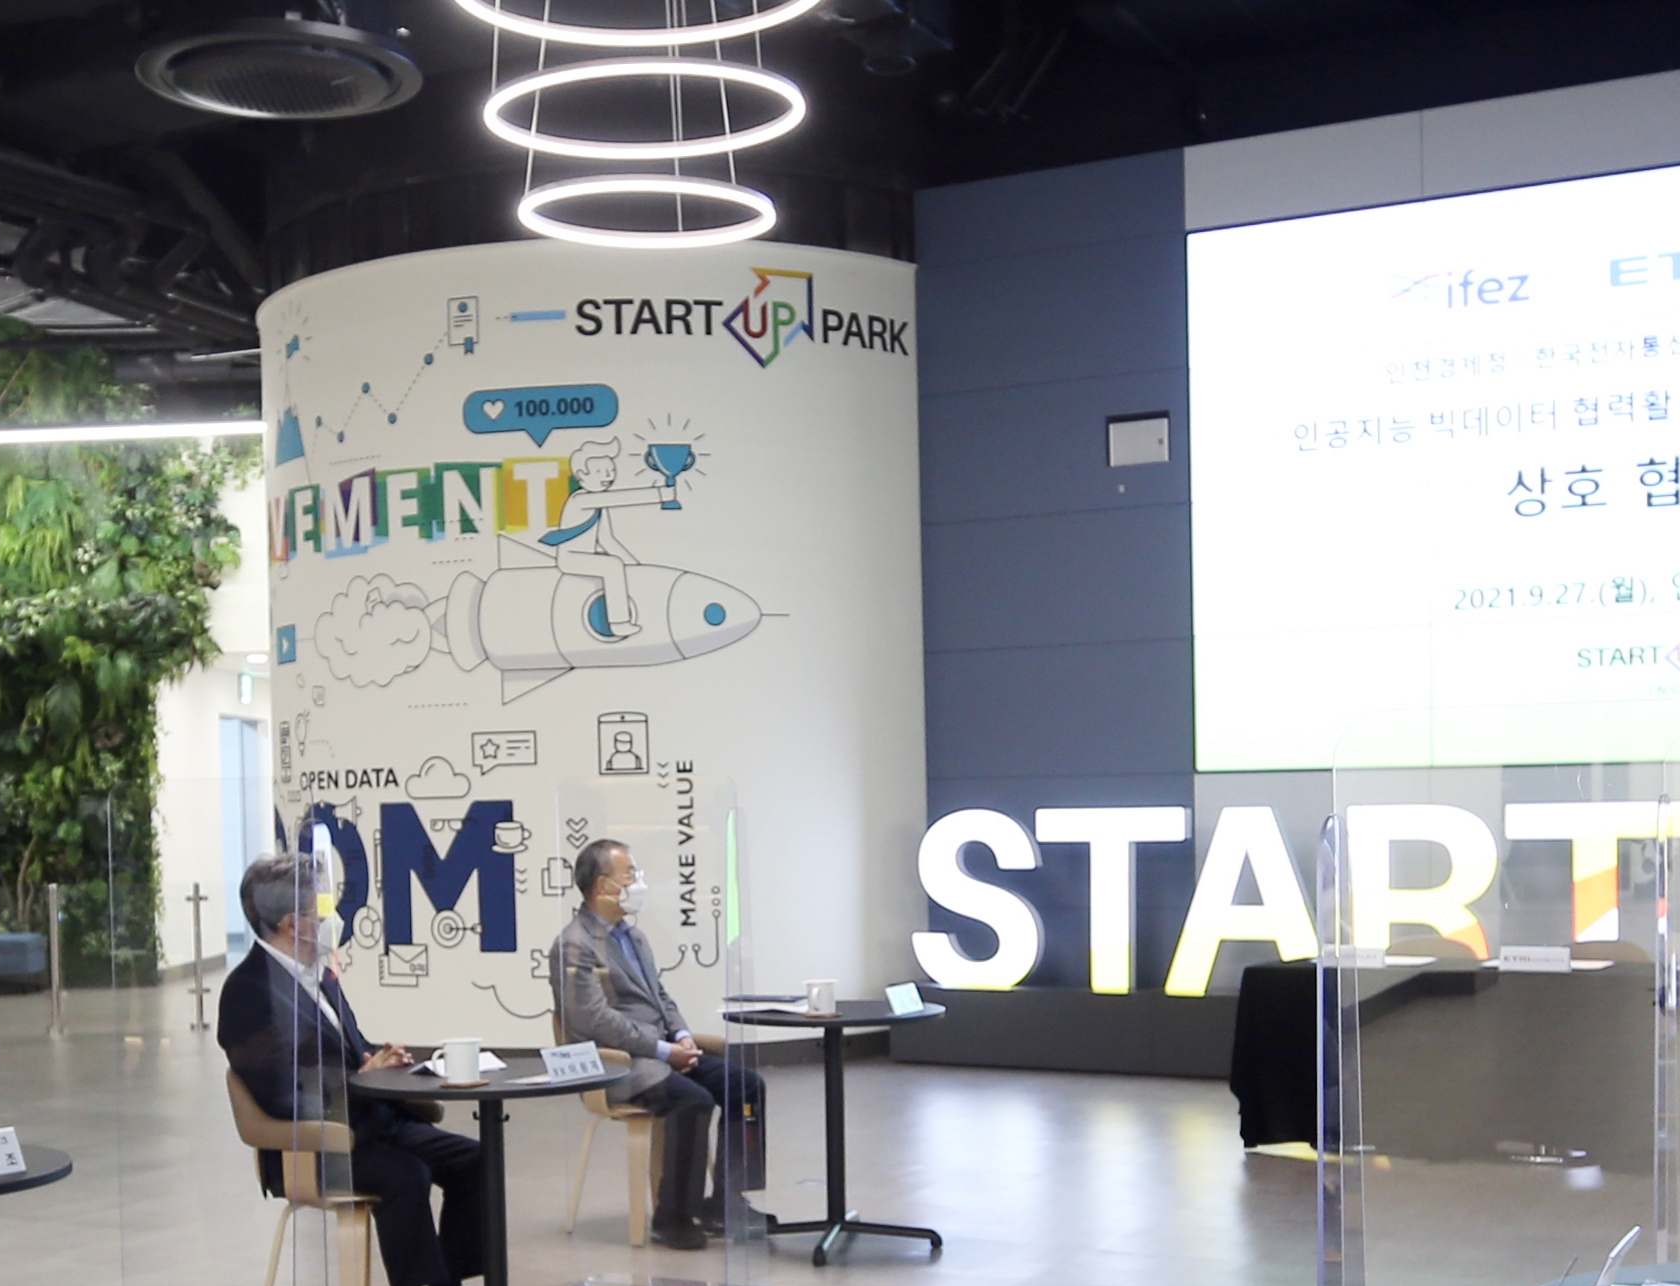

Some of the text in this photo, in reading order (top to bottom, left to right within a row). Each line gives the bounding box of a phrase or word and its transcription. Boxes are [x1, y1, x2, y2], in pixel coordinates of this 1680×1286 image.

[1446, 269, 1530, 309] ifez
[576, 297, 909, 356] START UP PARK
[1387, 352, 1505, 384] 인천경제청
[513, 397, 595, 419] 100.000
[1294, 416, 1416, 452] 인공지능
[1430, 400, 1556, 438] 빅데이터
[1507, 463, 1608, 517] 상호
[1577, 645, 1664, 668] START
[300, 768, 399, 791] OPEN DATA
[676, 759, 697, 927] MAKE VALUE
